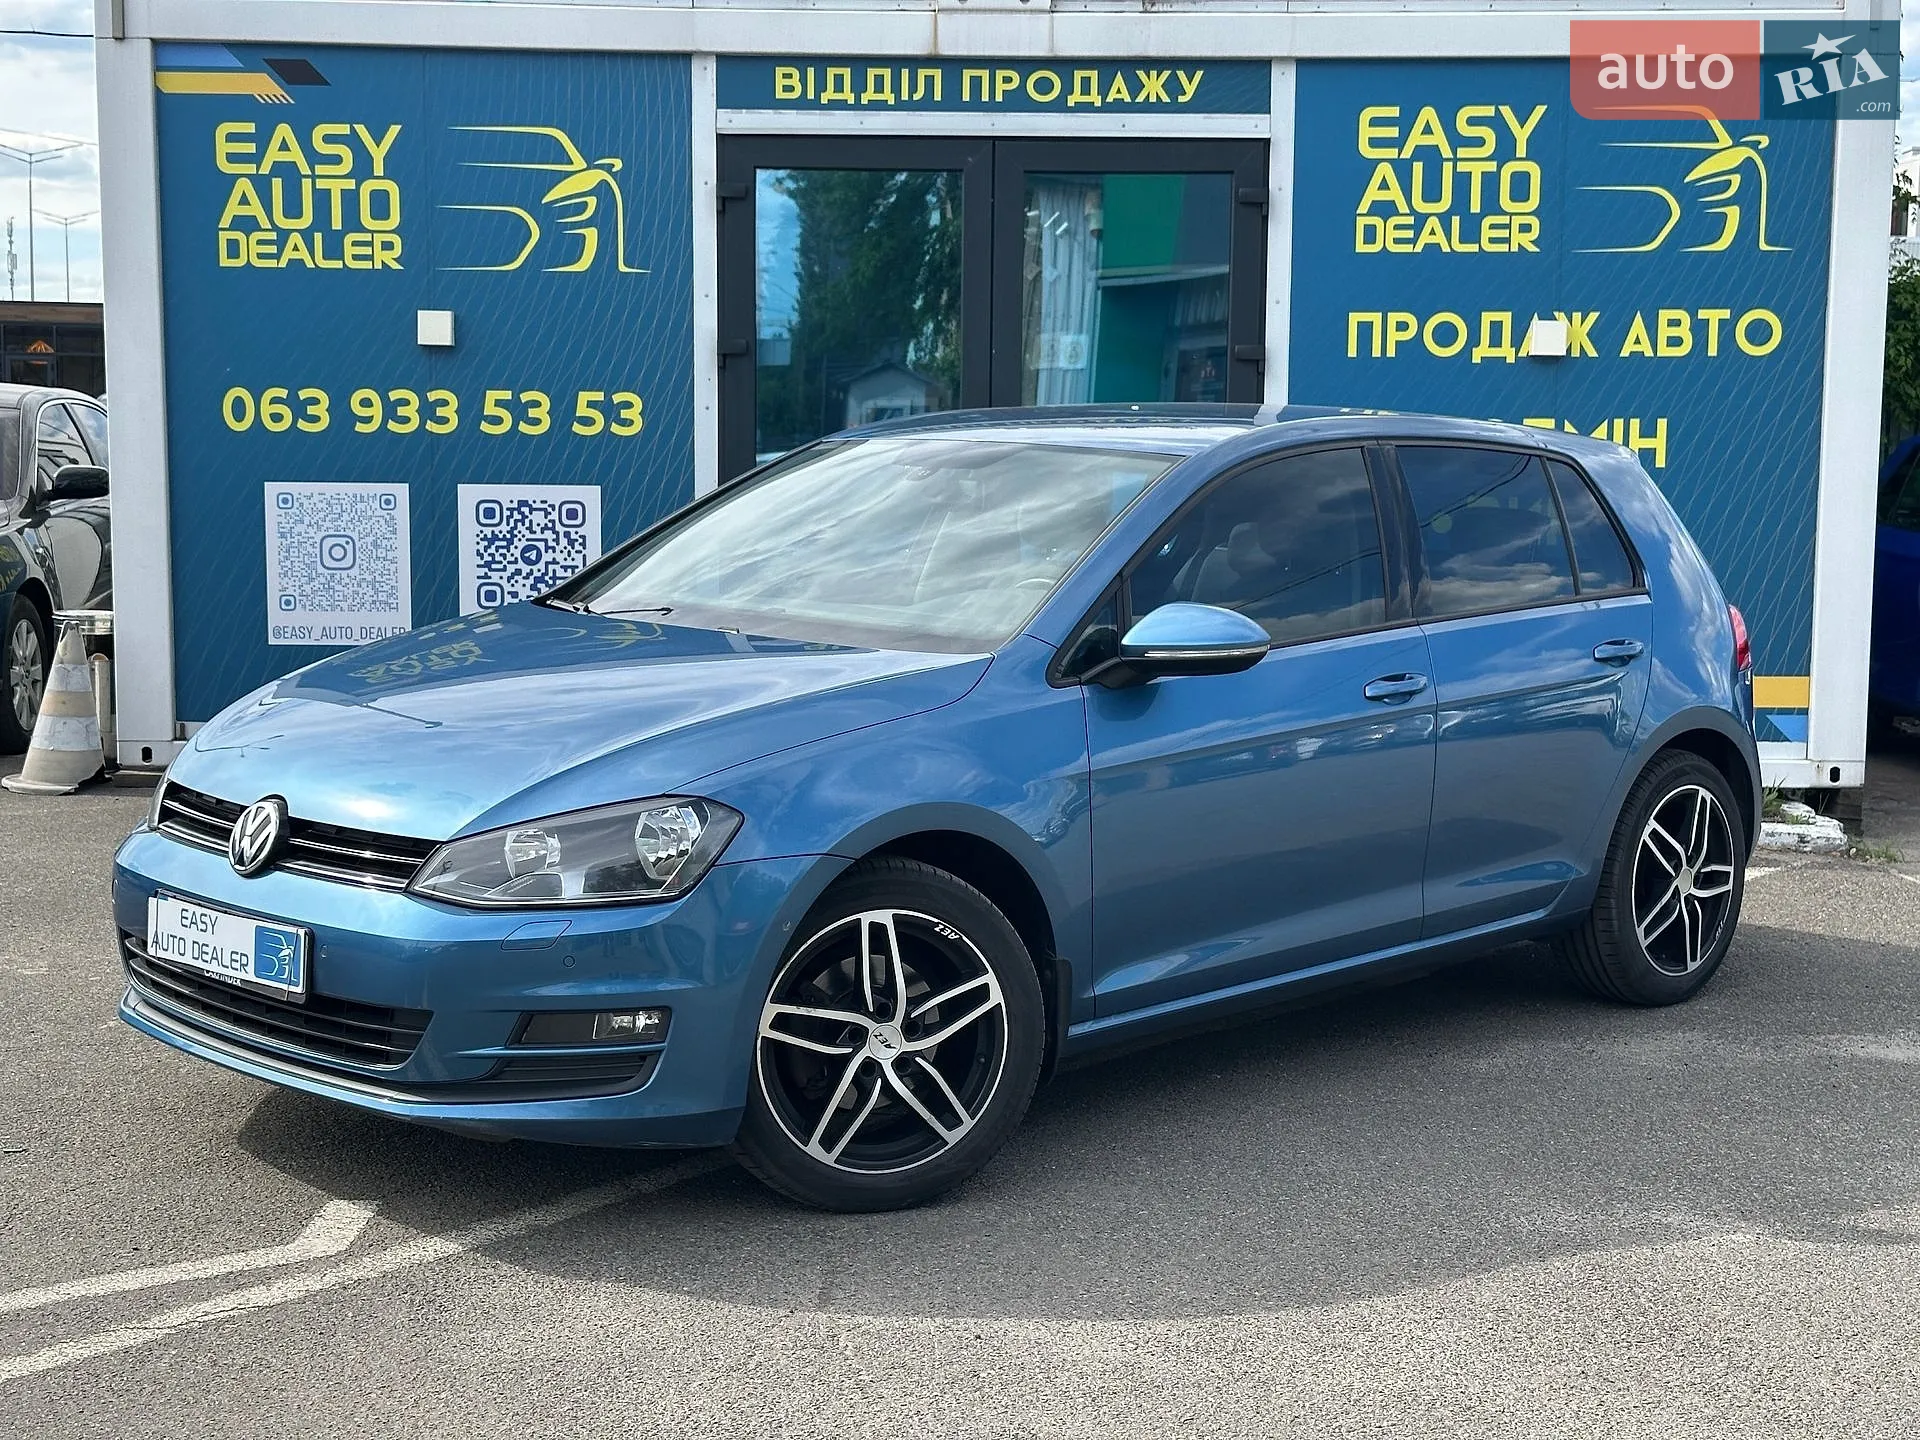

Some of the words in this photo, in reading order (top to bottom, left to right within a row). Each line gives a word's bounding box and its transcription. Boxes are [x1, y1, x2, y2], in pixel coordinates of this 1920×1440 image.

[774, 66, 943, 104] ВІДДІЛ
[962, 68, 1204, 106] ПРОДАЖУ
[214, 122, 402, 176] EASY
[1357, 104, 1548, 159] EASY
[219, 178, 401, 230] AUTO
[1357, 160, 1542, 214] AUTO
[218, 231, 404, 270] DEALER
[1355, 215, 1541, 253] DEALER
[1619, 309, 1783, 357] АВТО
[222, 387, 331, 433] 063
[349, 388, 459, 434] 933
[480, 390, 551, 435] 53
[572, 391, 643, 436] 53
[180, 907, 219, 936] EASY
[933, 923, 960, 940] AEZ
[151, 930, 187, 957] AUTO
[191, 940, 249, 974] DEALER
